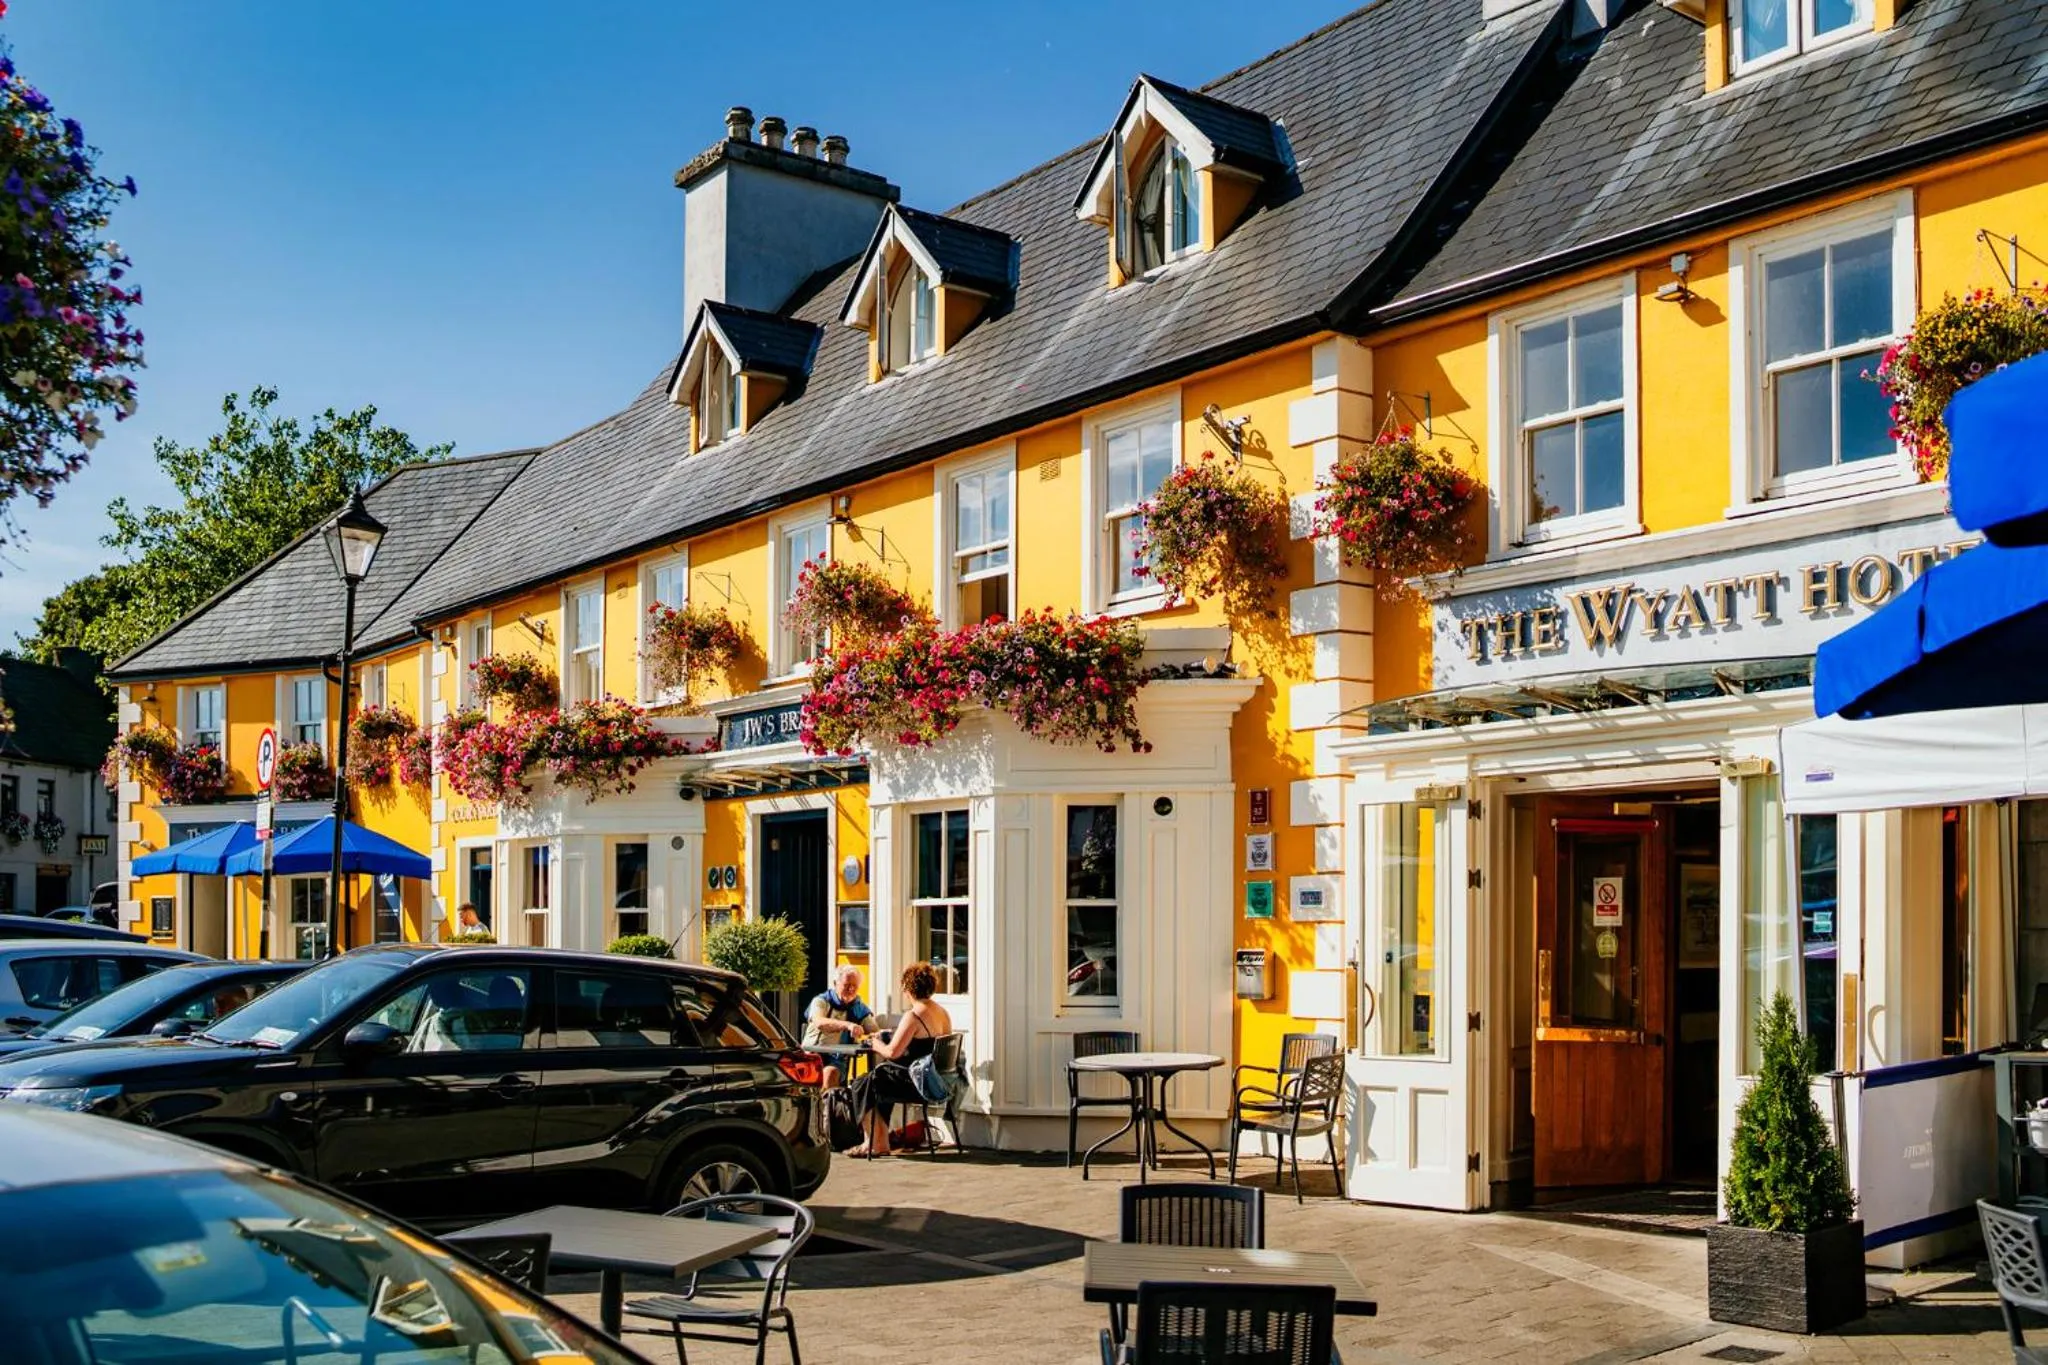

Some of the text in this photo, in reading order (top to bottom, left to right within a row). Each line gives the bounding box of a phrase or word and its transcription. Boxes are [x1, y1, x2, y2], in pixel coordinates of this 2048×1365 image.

[1460, 605, 1561, 661] THE
[1565, 569, 1780, 648] WYATT
[743, 714, 775, 743] JW'S
[263, 741, 271, 777] P
